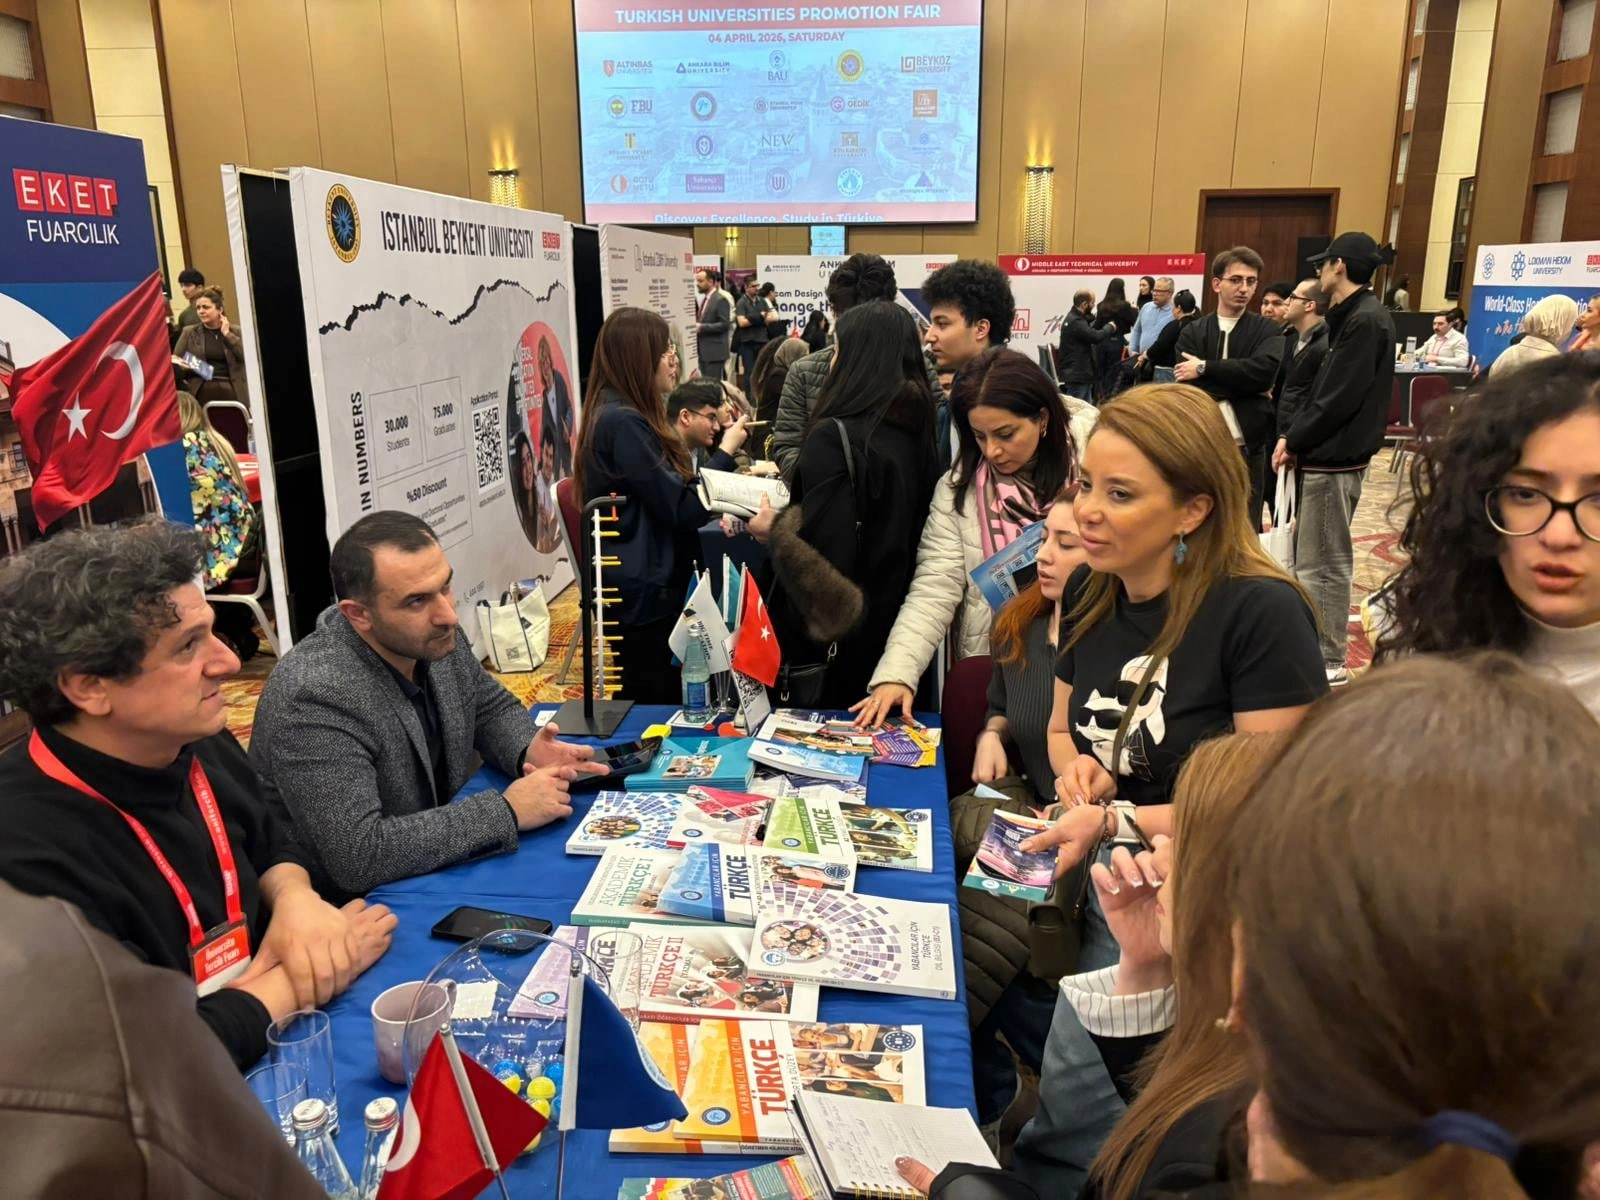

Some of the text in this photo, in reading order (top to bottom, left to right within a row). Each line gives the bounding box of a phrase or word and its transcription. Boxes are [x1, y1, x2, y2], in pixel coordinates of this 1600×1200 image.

[615, 4, 941, 24] TURKISH UNIVERSITIES PROMOTION FAIR
[708, 31, 846, 44] 04 APRIL 2026, SATURDAY
[916, 55, 952, 66] BEYKOZ
[767, 71, 788, 81] BAU
[631, 100, 653, 114] FBU
[19, 175, 113, 211] EKET
[26, 219, 120, 245] FUARCILIK
[442, 219, 486, 256] BEYKENT
[487, 225, 534, 259] UNIVERSITY
[1167, 258, 1194, 266] EKET
[1532, 267, 1564, 275] UNIVERSITY
[793, 289, 823, 299] Design
[1484, 295, 1525, 313] World-Class
[776, 301, 833, 314] ange th
[433, 403, 454, 419] 75.000
[385, 415, 409, 433] 30.000
[350, 391, 372, 512] IN NUMBERS
[422, 477, 448, 497] Discount
[812, 808, 840, 846] TÜRKÇE
[618, 862, 651, 906] TÜRKÇE
[724, 854, 751, 900] TÜRKÇE
[649, 946, 683, 997] TÜRKÇE
[736, 1057, 749, 1114] YABANCILAR
[750, 1039, 786, 1115] TÜRKÇE
